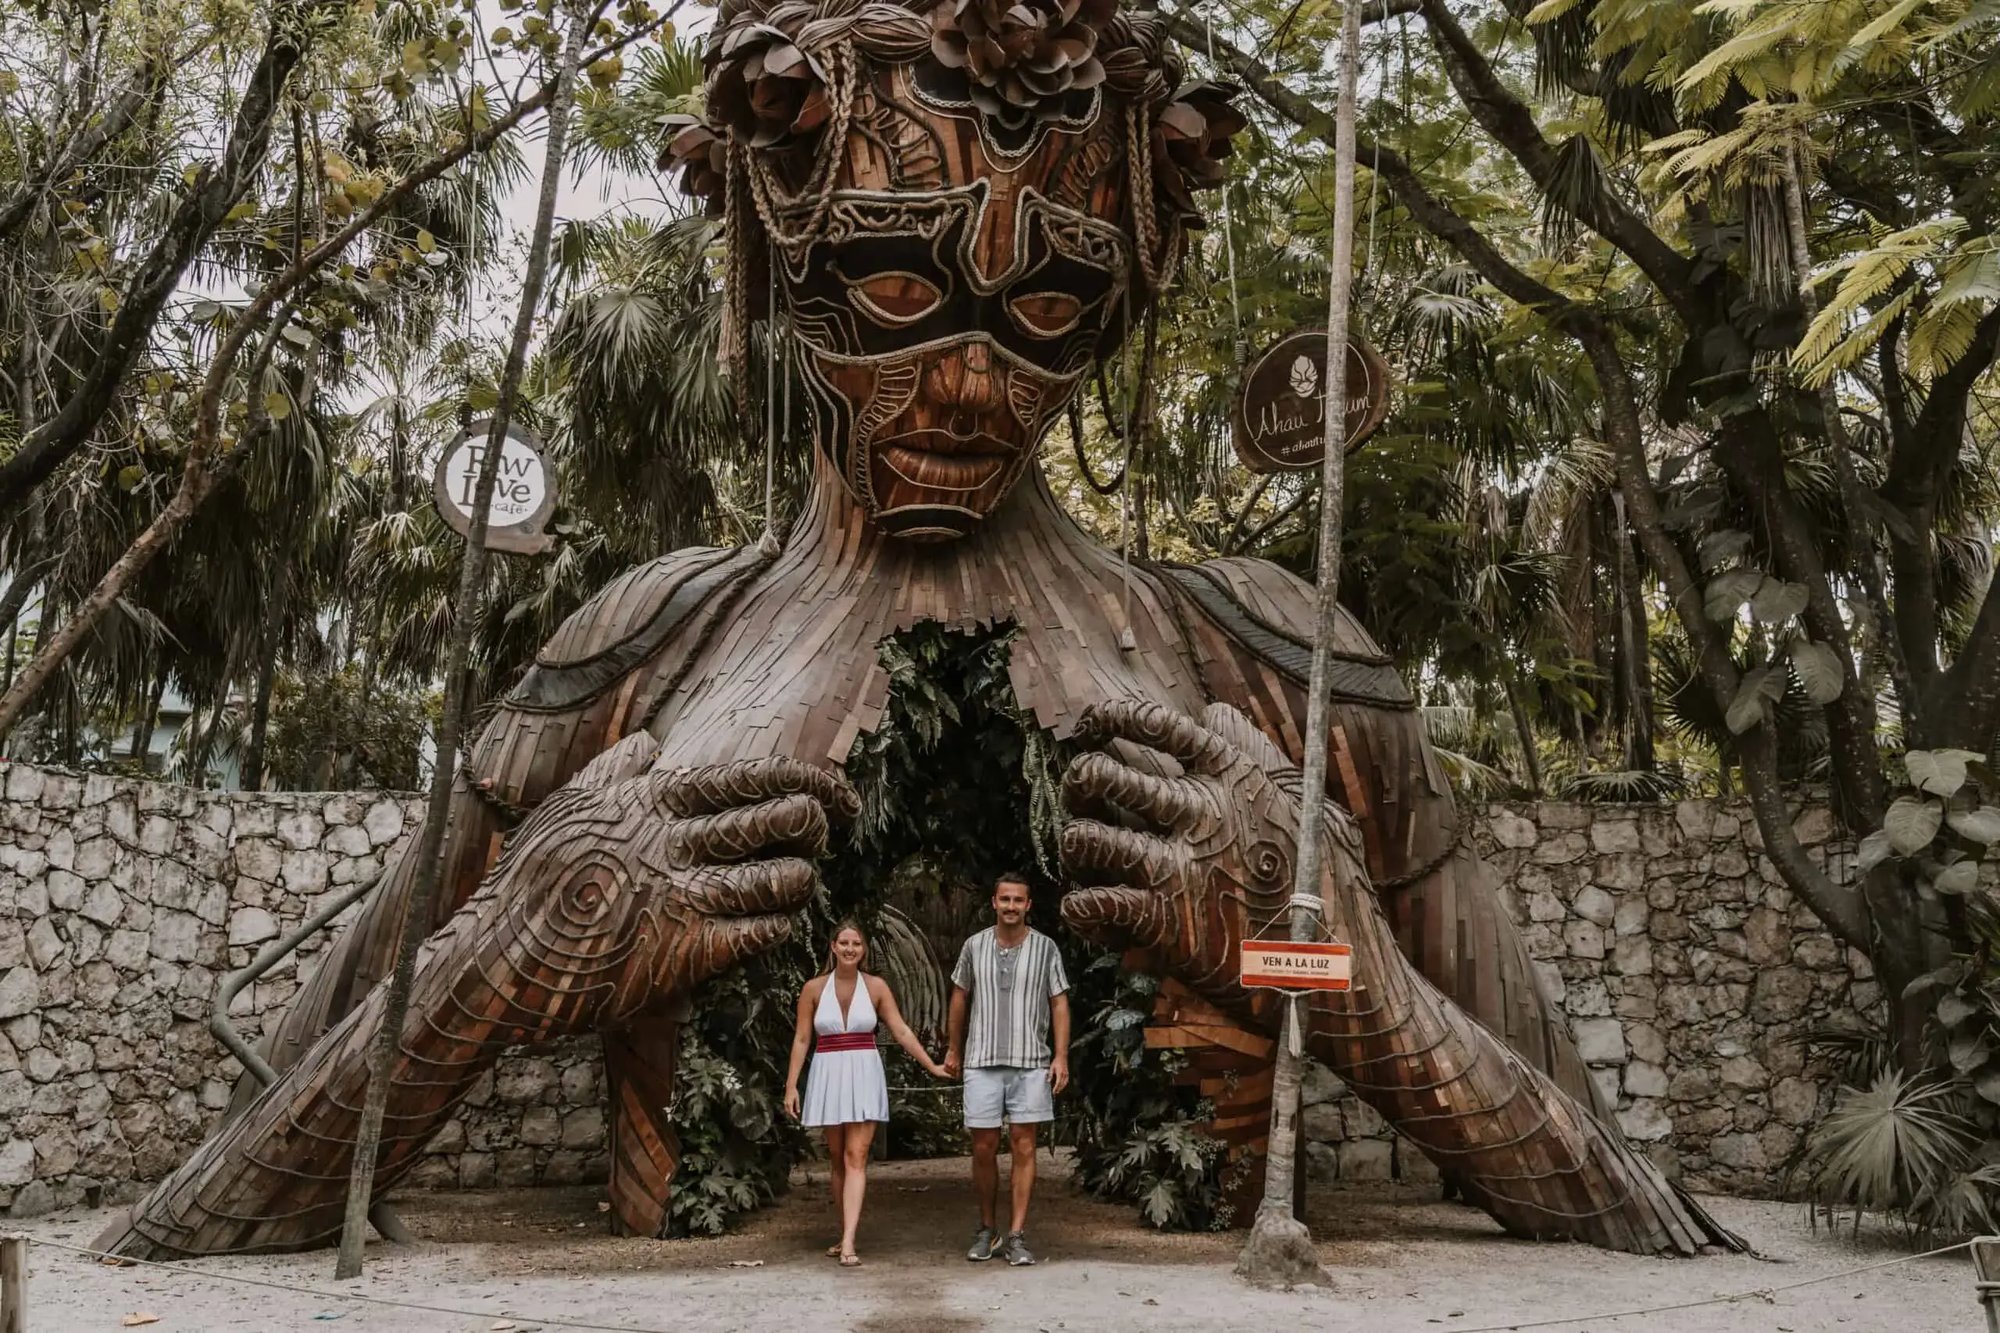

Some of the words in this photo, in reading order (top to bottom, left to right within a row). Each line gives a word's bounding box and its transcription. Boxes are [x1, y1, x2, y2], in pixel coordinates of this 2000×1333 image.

[463, 445, 535, 477] Rw
[457, 475, 531, 506] Lve
[1262, 956, 1282, 966] VEN
[1285, 958, 1292, 967] A
[1295, 958, 1308, 968] LA
[1310, 959, 1329, 969] LUZ
